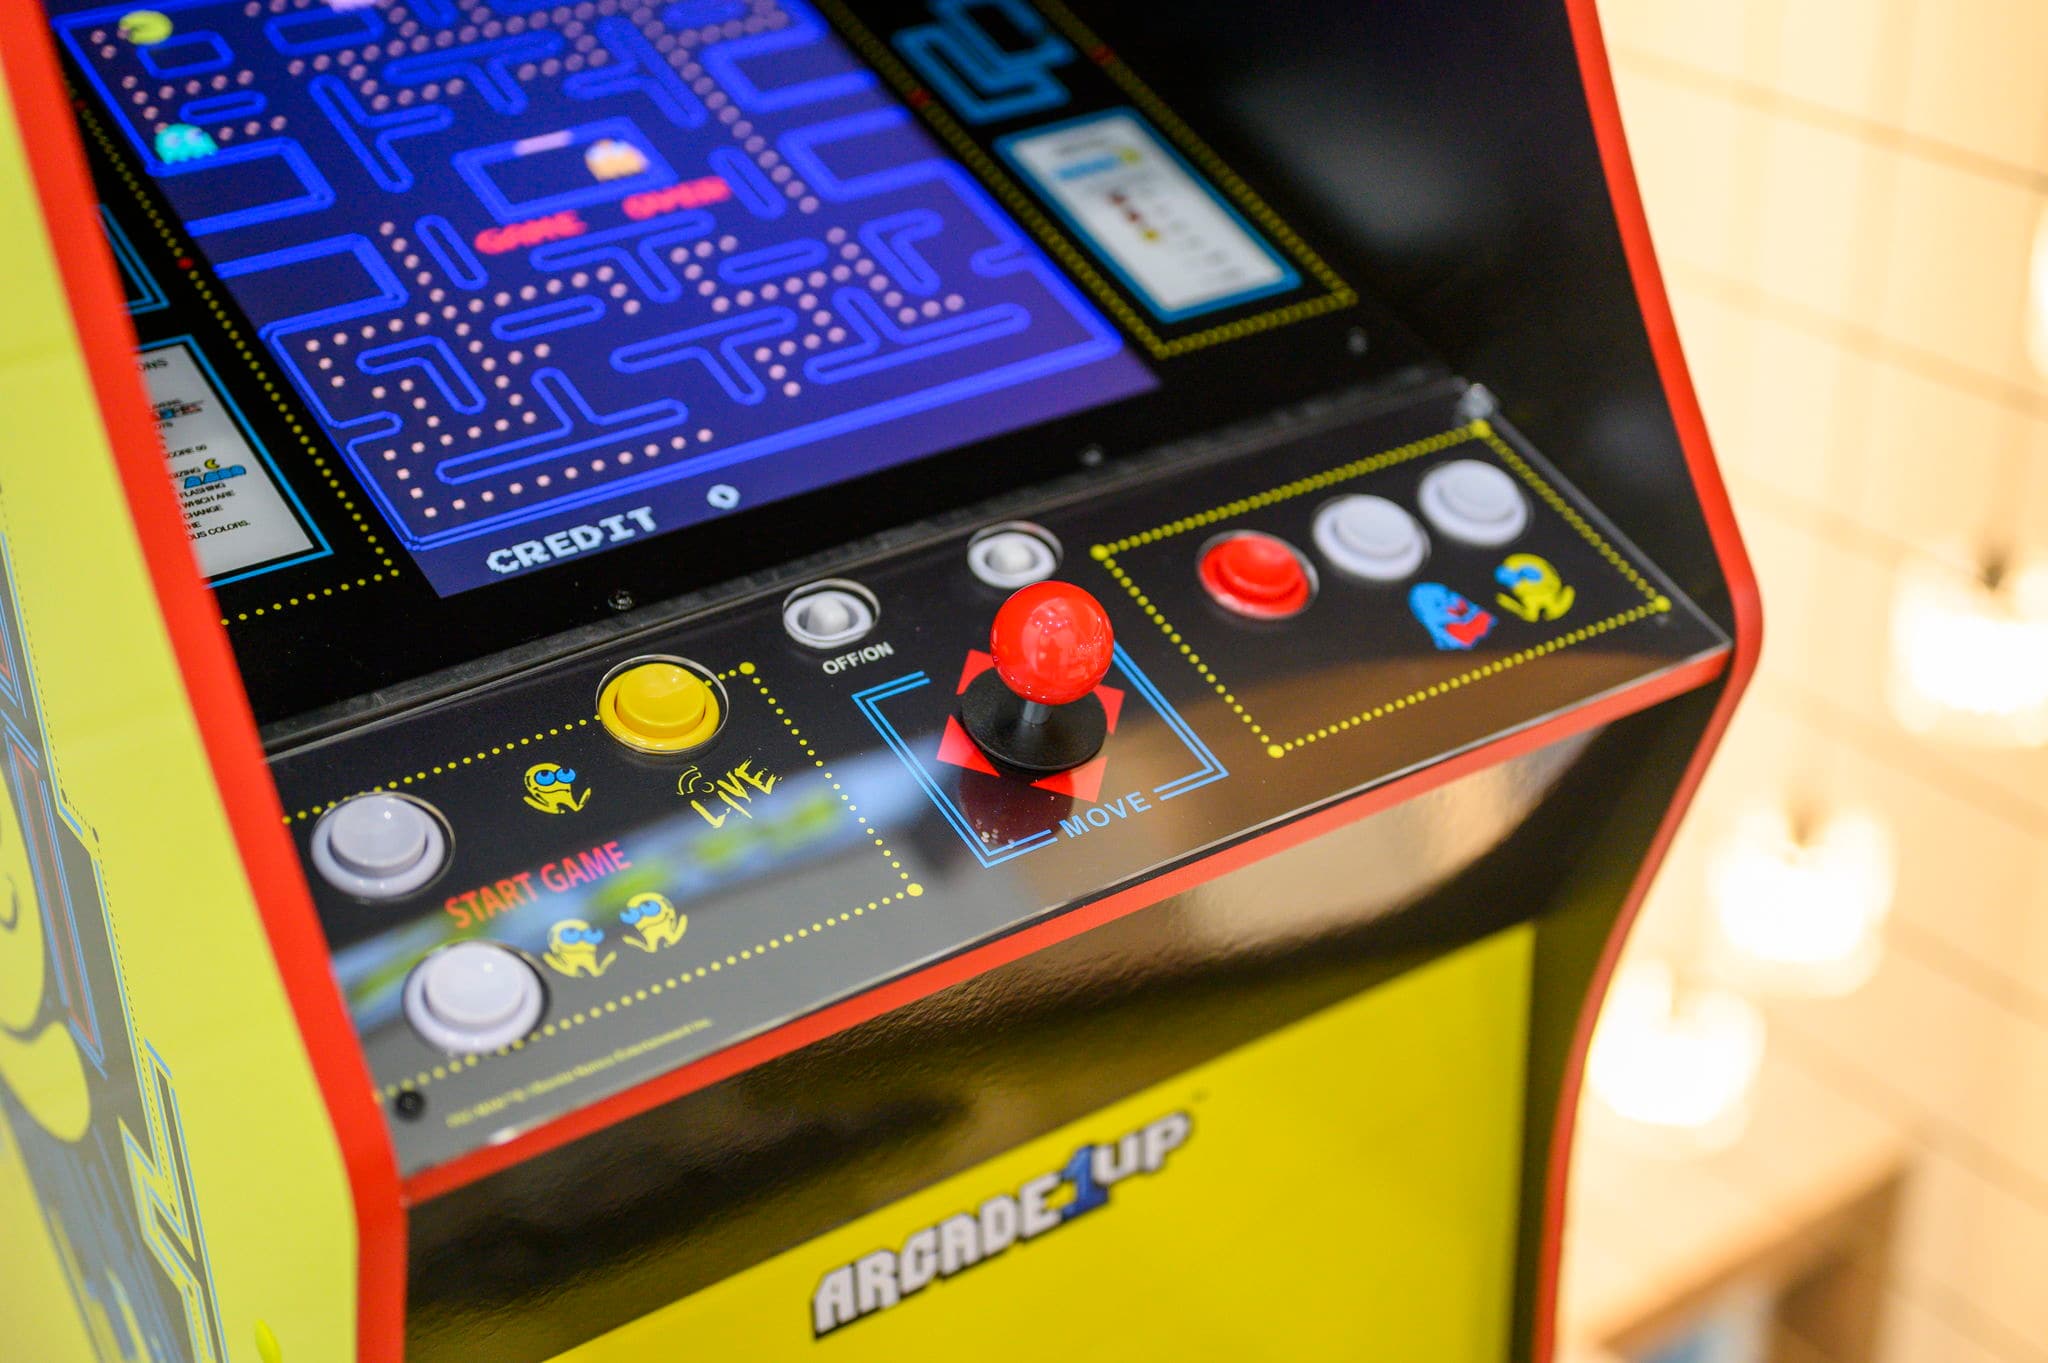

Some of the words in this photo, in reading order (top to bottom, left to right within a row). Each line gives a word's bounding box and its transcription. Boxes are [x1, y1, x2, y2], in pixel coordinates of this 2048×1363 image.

[485, 505, 658, 574] CREDIT
[706, 483, 741, 510] 0
[822, 641, 895, 675] OFF/ON
[690, 756, 778, 829] LIVE
[1059, 791, 1152, 838] MOVE
[444, 871, 539, 929] START
[539, 840, 633, 893] GAME
